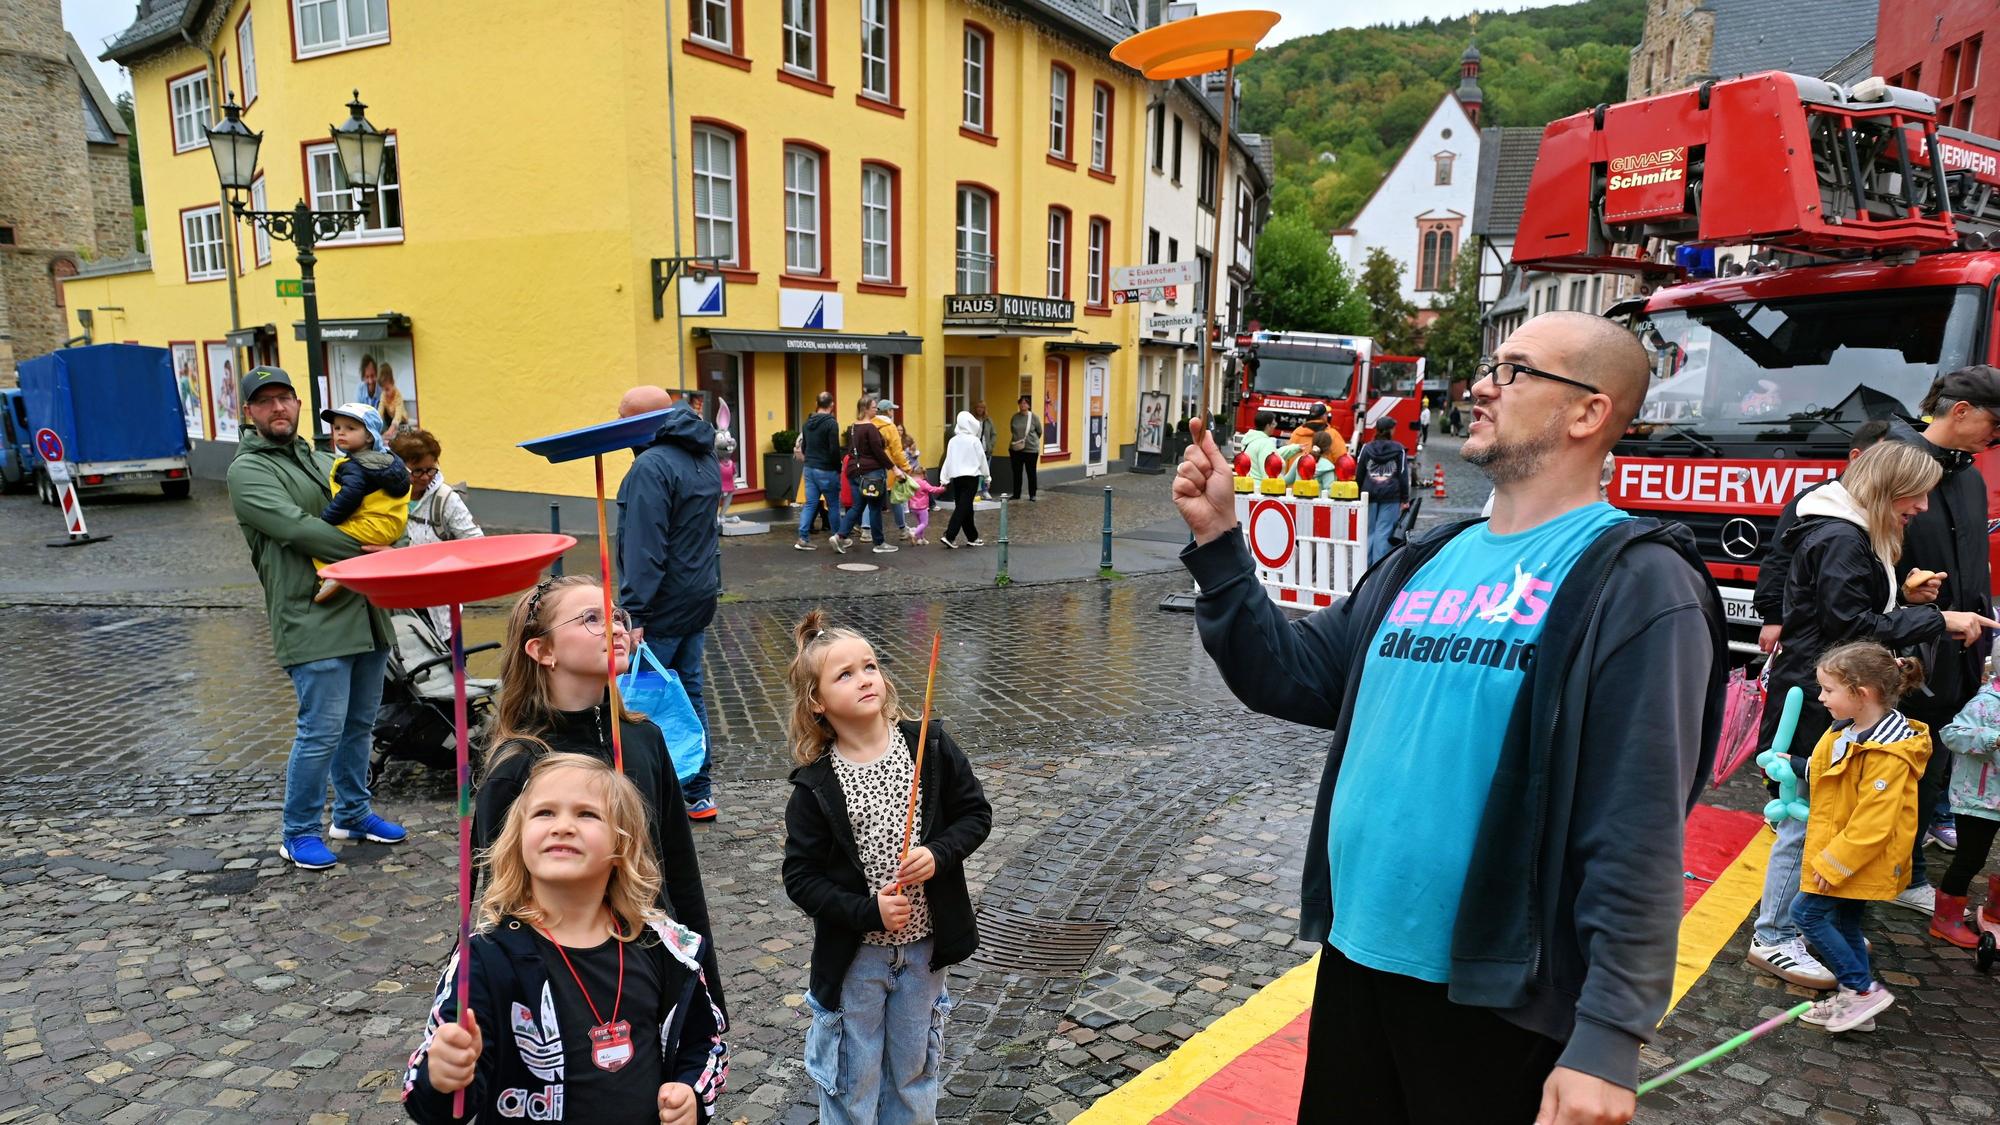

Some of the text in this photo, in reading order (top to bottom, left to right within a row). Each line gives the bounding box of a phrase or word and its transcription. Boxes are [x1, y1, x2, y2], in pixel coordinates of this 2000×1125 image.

[1610, 146, 1684, 173] GIMAEX
[1608, 168, 1683, 191] Schmitz
[1136, 266, 1177, 277] Euskirchen
[1137, 276, 1166, 286] Bahnhof
[952, 298, 1071, 319] HAUS KOLVENBACH
[1149, 315, 1193, 328] Langenhecke
[321, 328, 359, 339] Ravensburger
[786, 339, 817, 349] ENTDECKEN,
[817, 342, 827, 350] was
[827, 341, 844, 350] wirklich
[844, 342, 861, 351] wichtig
[1620, 463, 1837, 504] FEUERWE
[1727, 602, 1746, 618] BM
[497, 1083, 564, 1121] adi
